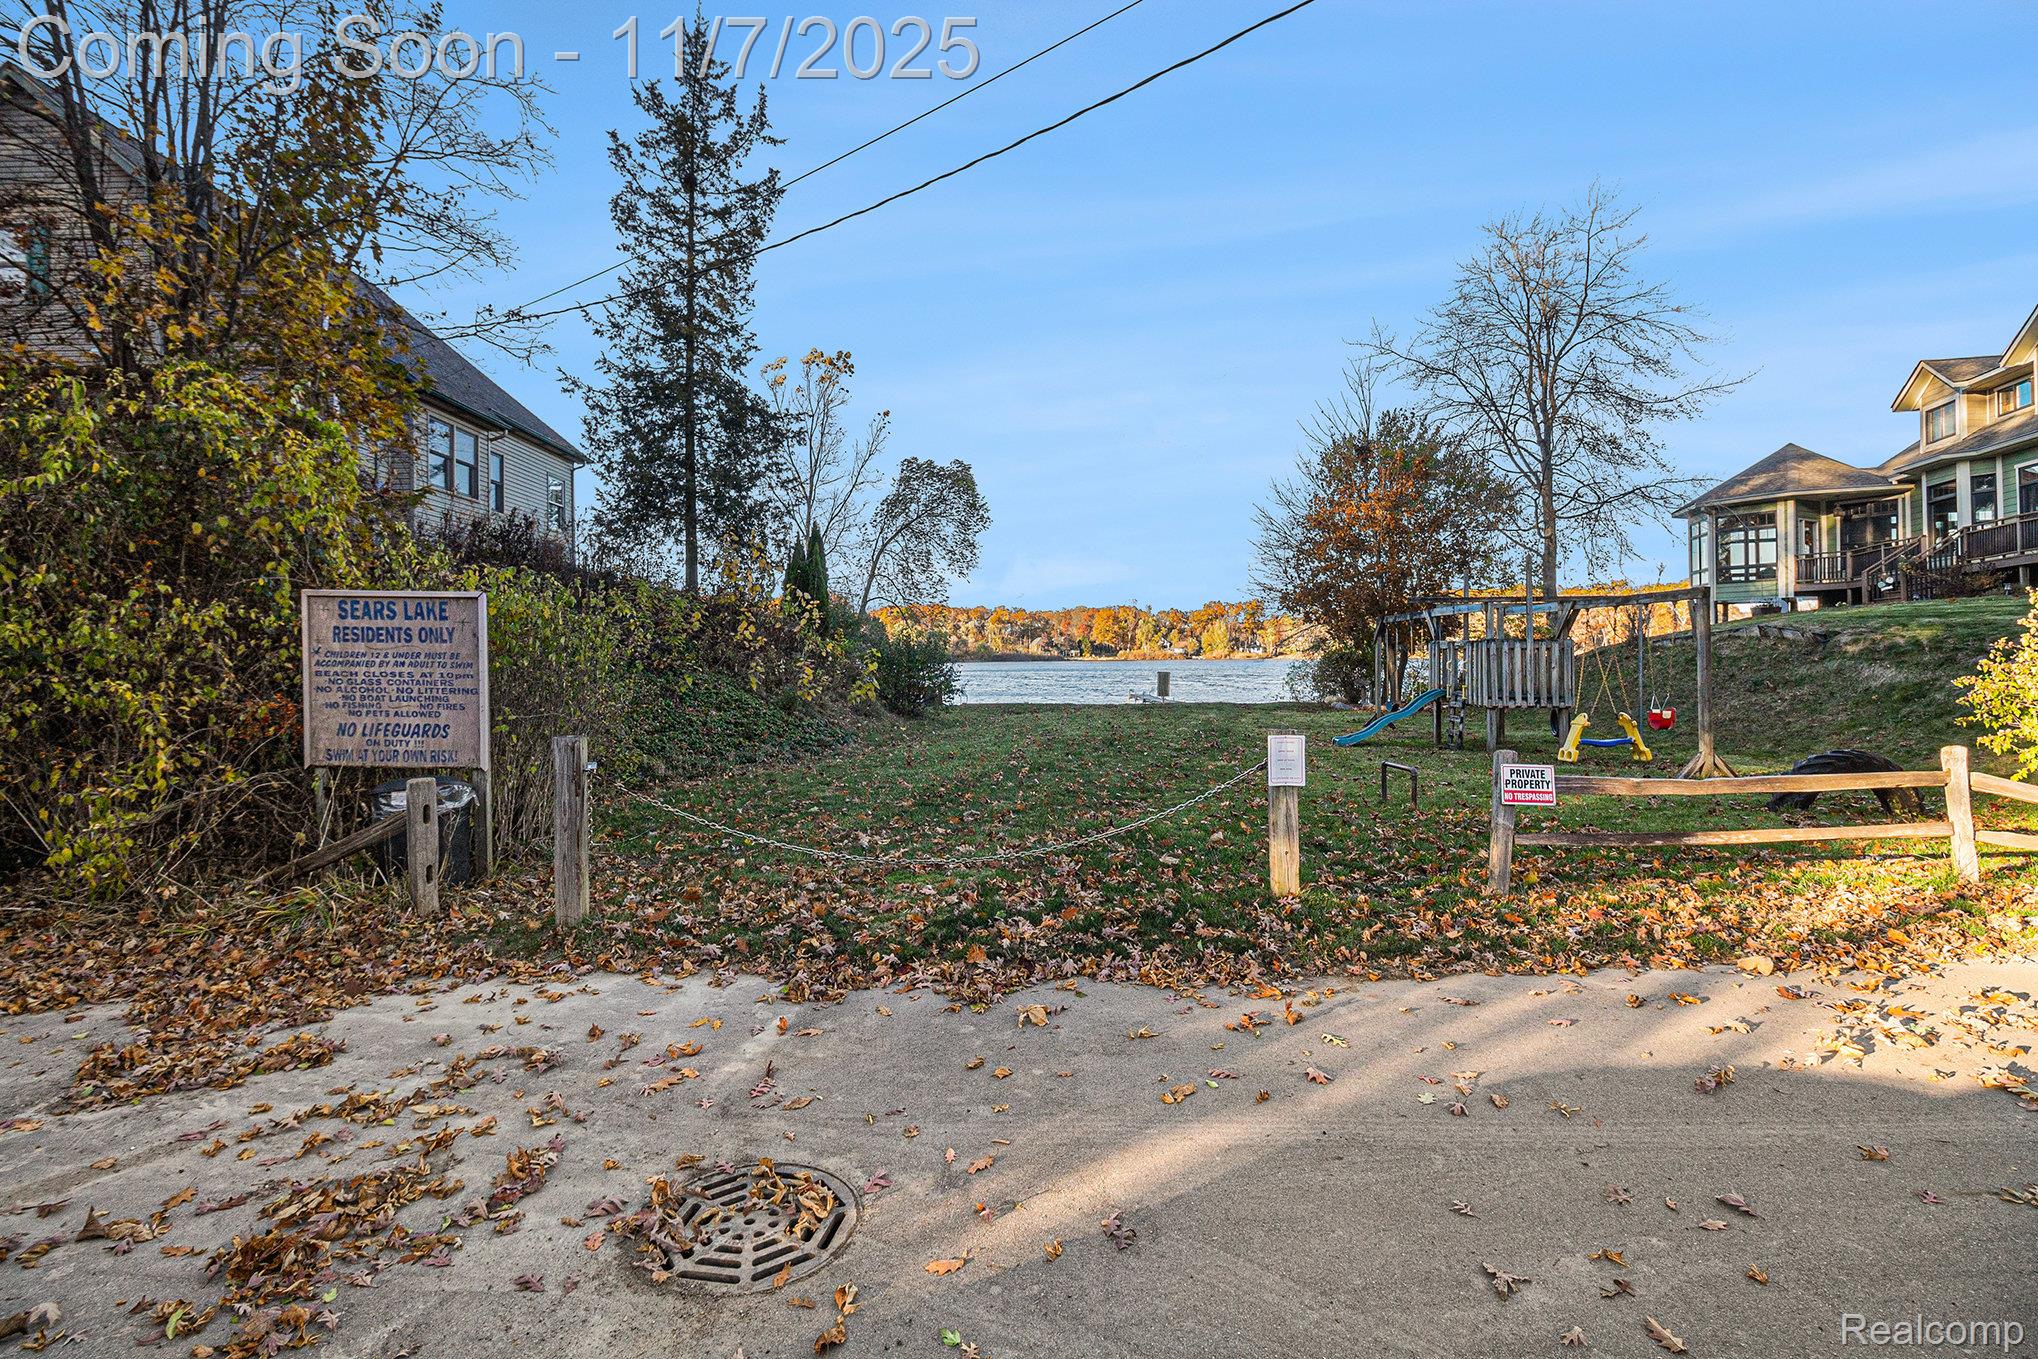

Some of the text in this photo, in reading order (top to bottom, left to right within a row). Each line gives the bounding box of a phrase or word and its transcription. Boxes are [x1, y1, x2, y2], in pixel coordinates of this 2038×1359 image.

[338, 599, 449, 621] SEARS LAKE
[332, 625, 456, 644] RESIDENTS ONLY
[324, 651, 367, 659] CHILDREN
[383, 651, 390, 659] &
[392, 651, 422, 660] UNDER
[423, 652, 447, 660] MUST
[449, 652, 461, 660] BE
[314, 659, 474, 669] ACCOMPANIED BY AN ADULT TO SWIM
[419, 671, 435, 679] AT
[438, 671, 475, 680] 10pm
[346, 678, 382, 686] GLASS
[386, 679, 455, 687] CONTAINERS
[336, 686, 390, 694] ALCOHOL
[417, 687, 479, 695] LITTERING
[360, 694, 387, 702] BOAT
[389, 695, 450, 703] LAUNCHING
[437, 703, 466, 711] FIRES
[365, 709, 390, 718] PETS
[393, 710, 442, 718] ALLOWED
[336, 722, 451, 739] NO LIFEGUARDS
[366, 738, 381, 747] ON
[384, 739, 411, 748] DUTY
[325, 748, 458, 763] SWIM AT YOUR OWN RISK!
[1509, 768, 1546, 779] PRIVATE
[1505, 779, 1551, 789] PROPERTY
[1504, 792, 1553, 801] NO TRESPASSING
